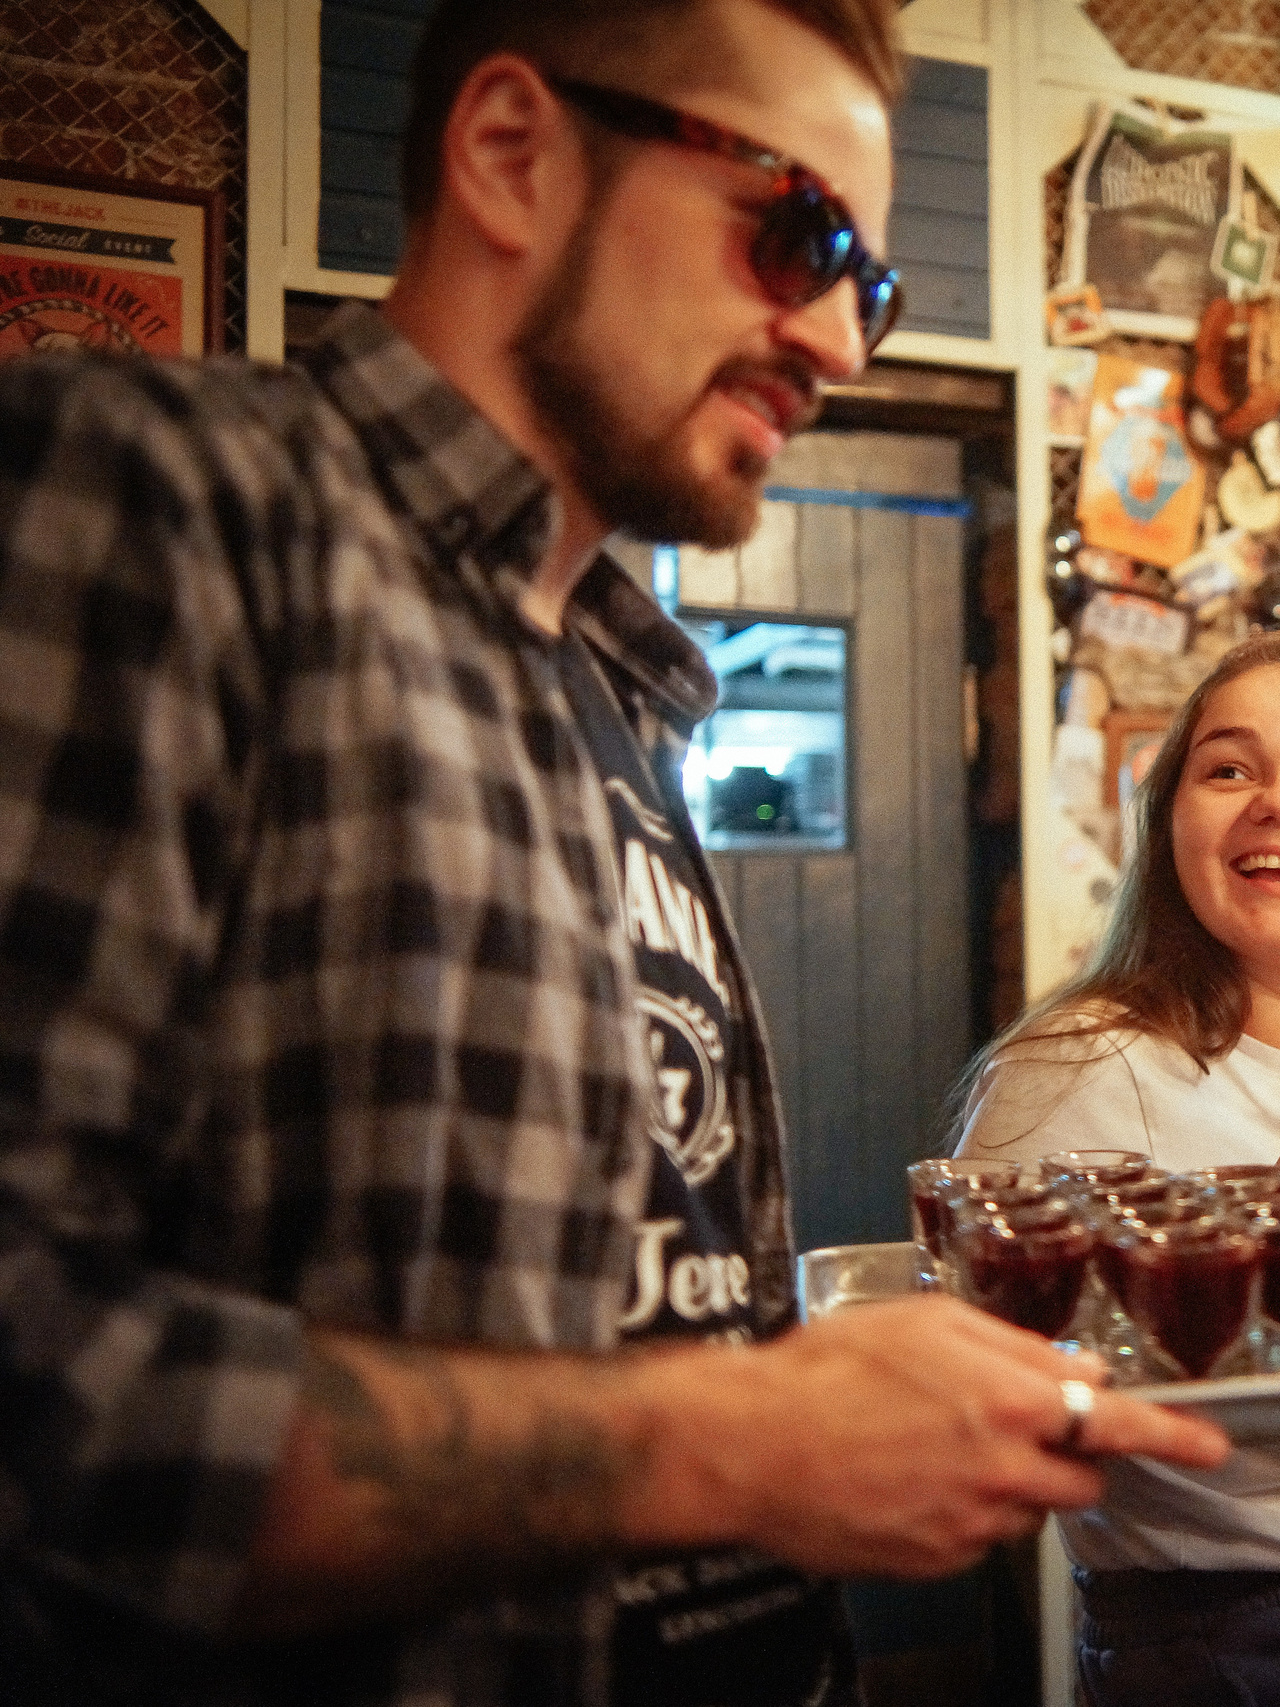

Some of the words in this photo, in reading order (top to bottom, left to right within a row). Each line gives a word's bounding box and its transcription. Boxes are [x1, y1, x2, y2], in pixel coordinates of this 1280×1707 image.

[24, 223, 91, 250] Social
[29, 265, 100, 299] GONNA
[102, 282, 149, 322] LIKE
[139, 314, 170, 338] IT
